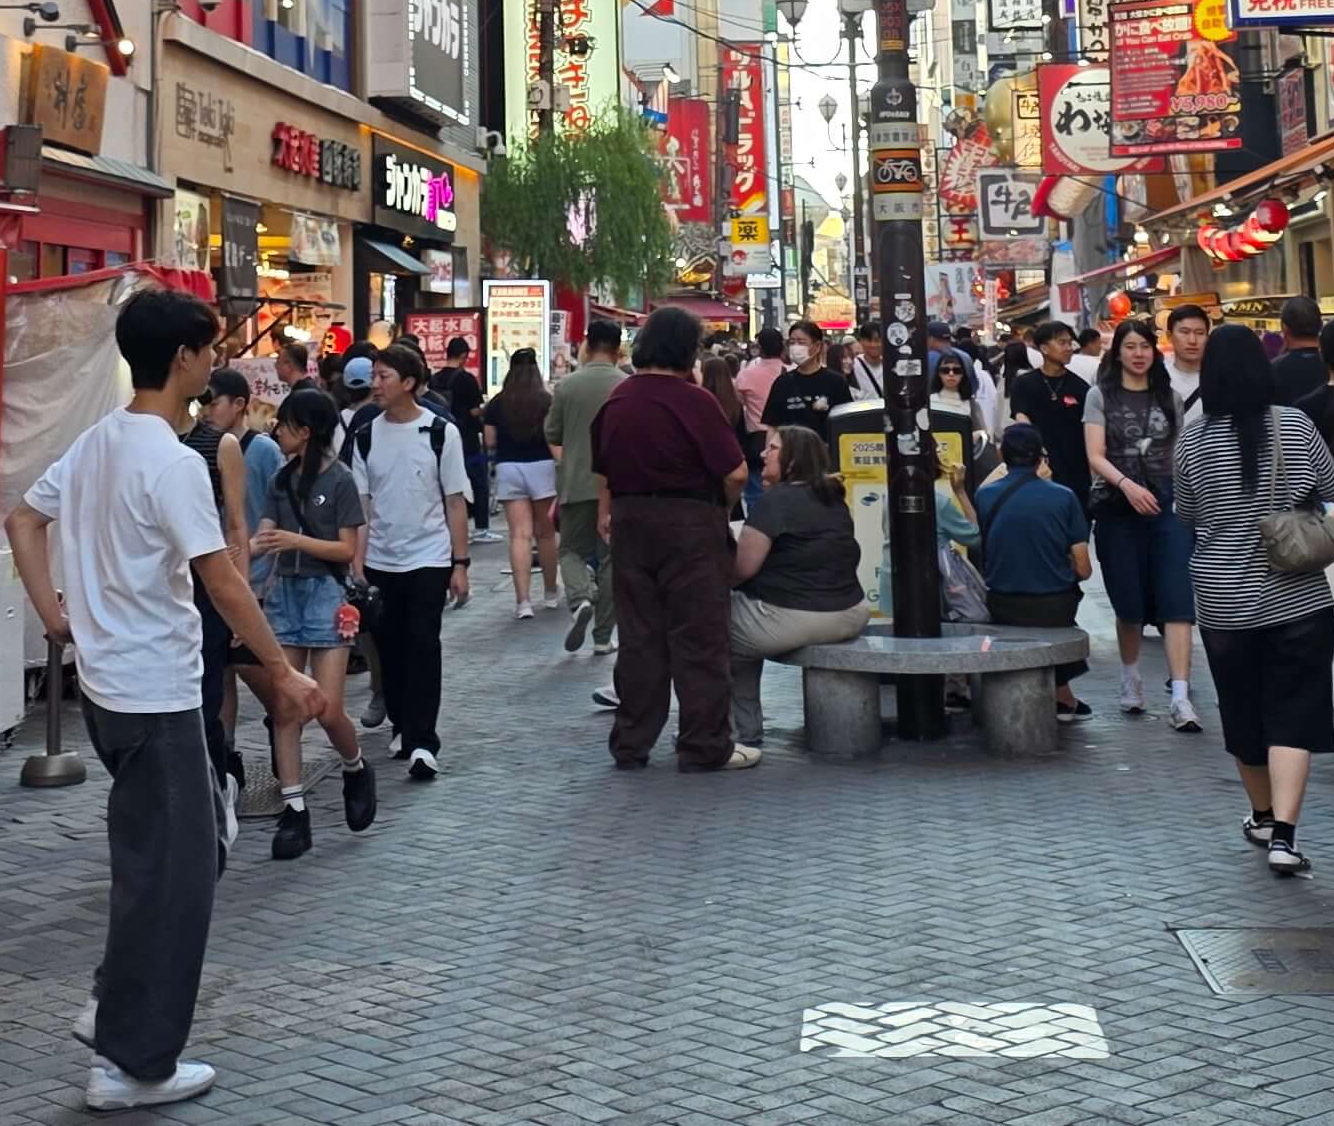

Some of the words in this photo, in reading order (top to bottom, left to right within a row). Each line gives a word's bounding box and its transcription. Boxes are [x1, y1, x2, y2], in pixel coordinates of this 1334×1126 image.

[385, 153, 429, 217] ジャンカラ
